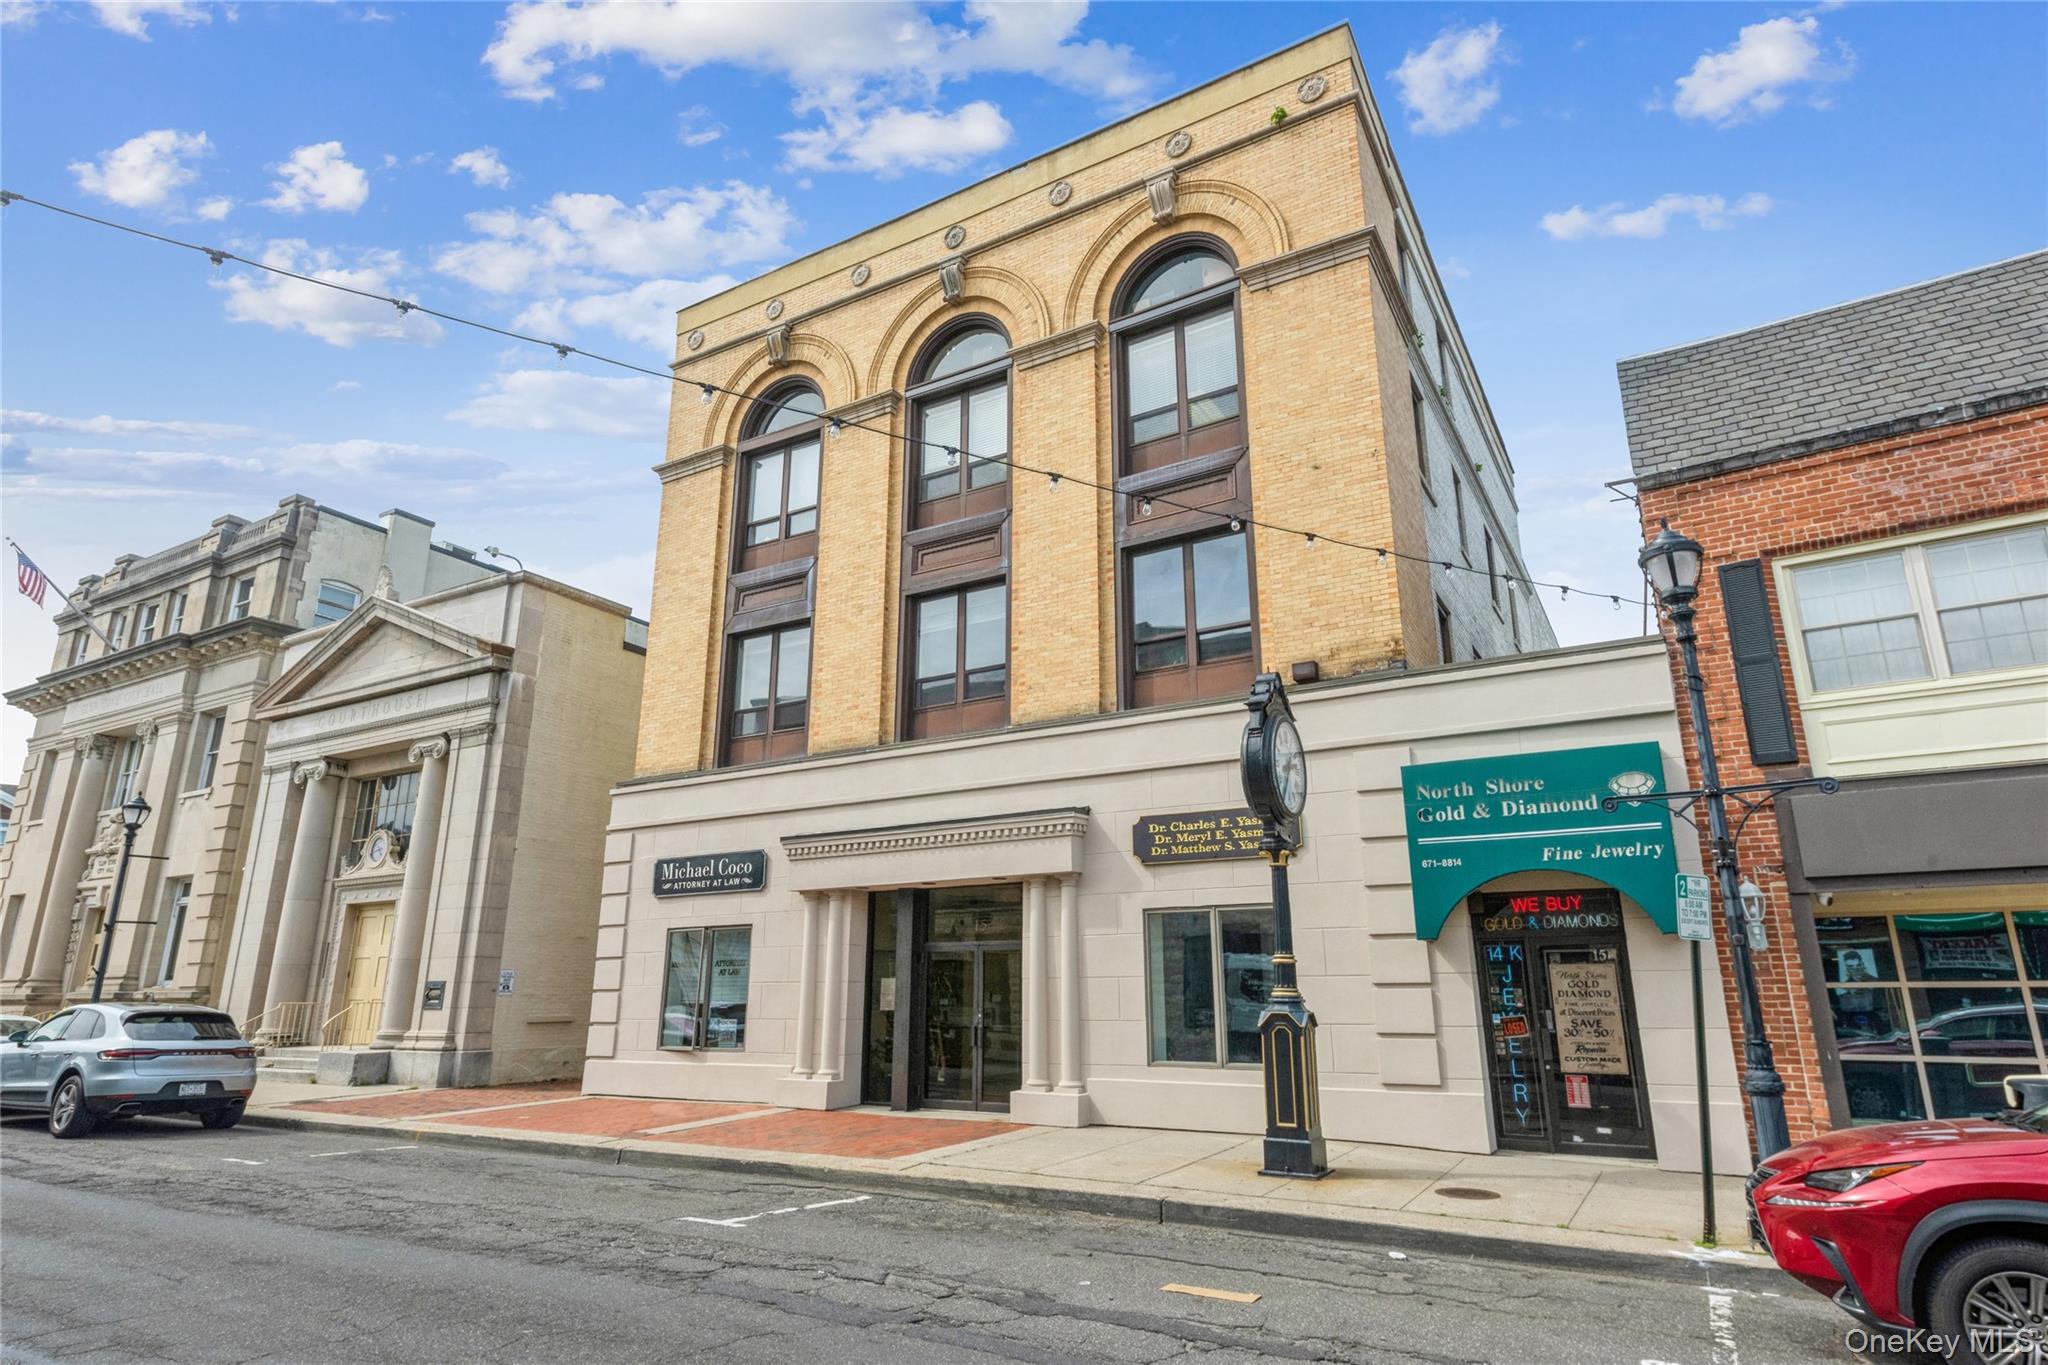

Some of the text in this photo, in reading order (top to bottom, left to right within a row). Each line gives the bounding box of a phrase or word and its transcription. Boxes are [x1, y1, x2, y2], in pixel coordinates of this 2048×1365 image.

[317, 692, 424, 726] COURTHOUSE
[1417, 779, 1545, 800] North Shore
[1417, 795, 1598, 823] Gold & Diamond
[1148, 816, 1263, 833] Dr. Charles E. Yas
[1154, 829, 1264, 845] Dr. Meryl E. Yasm
[1151, 840, 1260, 856] Dr. Matthew S. Yas
[1542, 846, 1583, 861] Fine
[1591, 842, 1664, 860] Jewelry
[661, 858, 752, 880] Michael Coco
[673, 878, 740, 890] ATTORNEY AT LAW
[1680, 880, 1686, 896] 2
[1511, 895, 1581, 913] WE BUY
[1484, 913, 1619, 932] GOLD & DIAMONDS
[1488, 945, 1523, 961] 14 K
[1568, 980, 1600, 988] GOLD
[1557, 989, 1612, 998] DIAMOND
[1571, 1018, 1604, 1029] SAVE
[1502, 964, 1529, 1128] JEELRY
